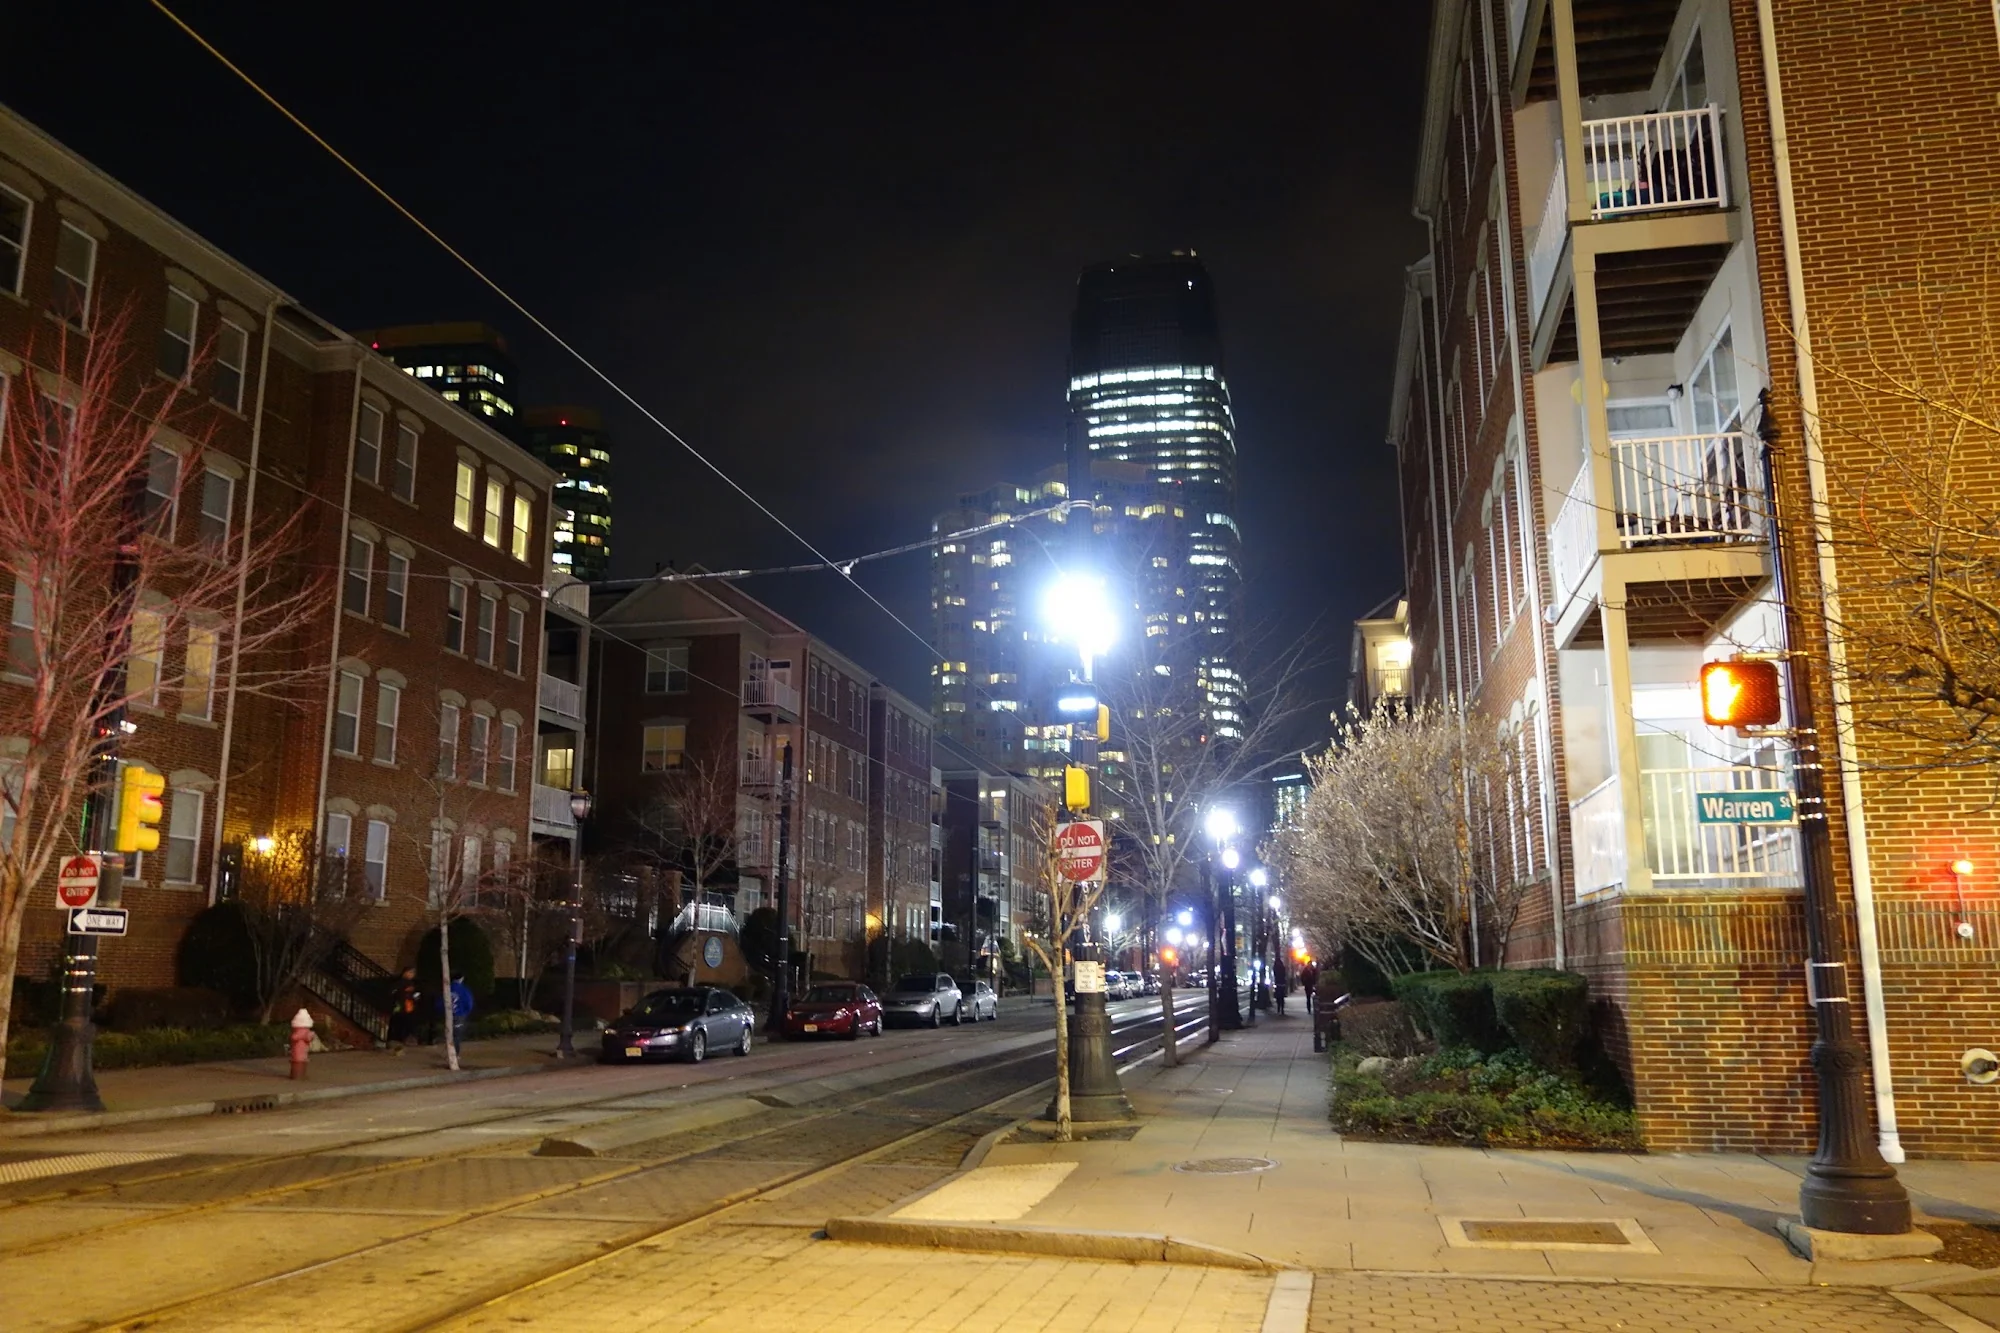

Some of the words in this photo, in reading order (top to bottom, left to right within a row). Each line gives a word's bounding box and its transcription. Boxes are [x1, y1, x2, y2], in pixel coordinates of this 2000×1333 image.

[1702, 797, 1775, 819] Warren
[1779, 796, 1792, 808] St
[1060, 837, 1074, 847] DO
[1077, 835, 1096, 846] NOT
[65, 867, 78, 877] DO
[79, 866, 95, 876] NOT
[65, 887, 90, 897] ENTER
[86, 915, 101, 926] ONE
[105, 916, 120, 926] WAY
